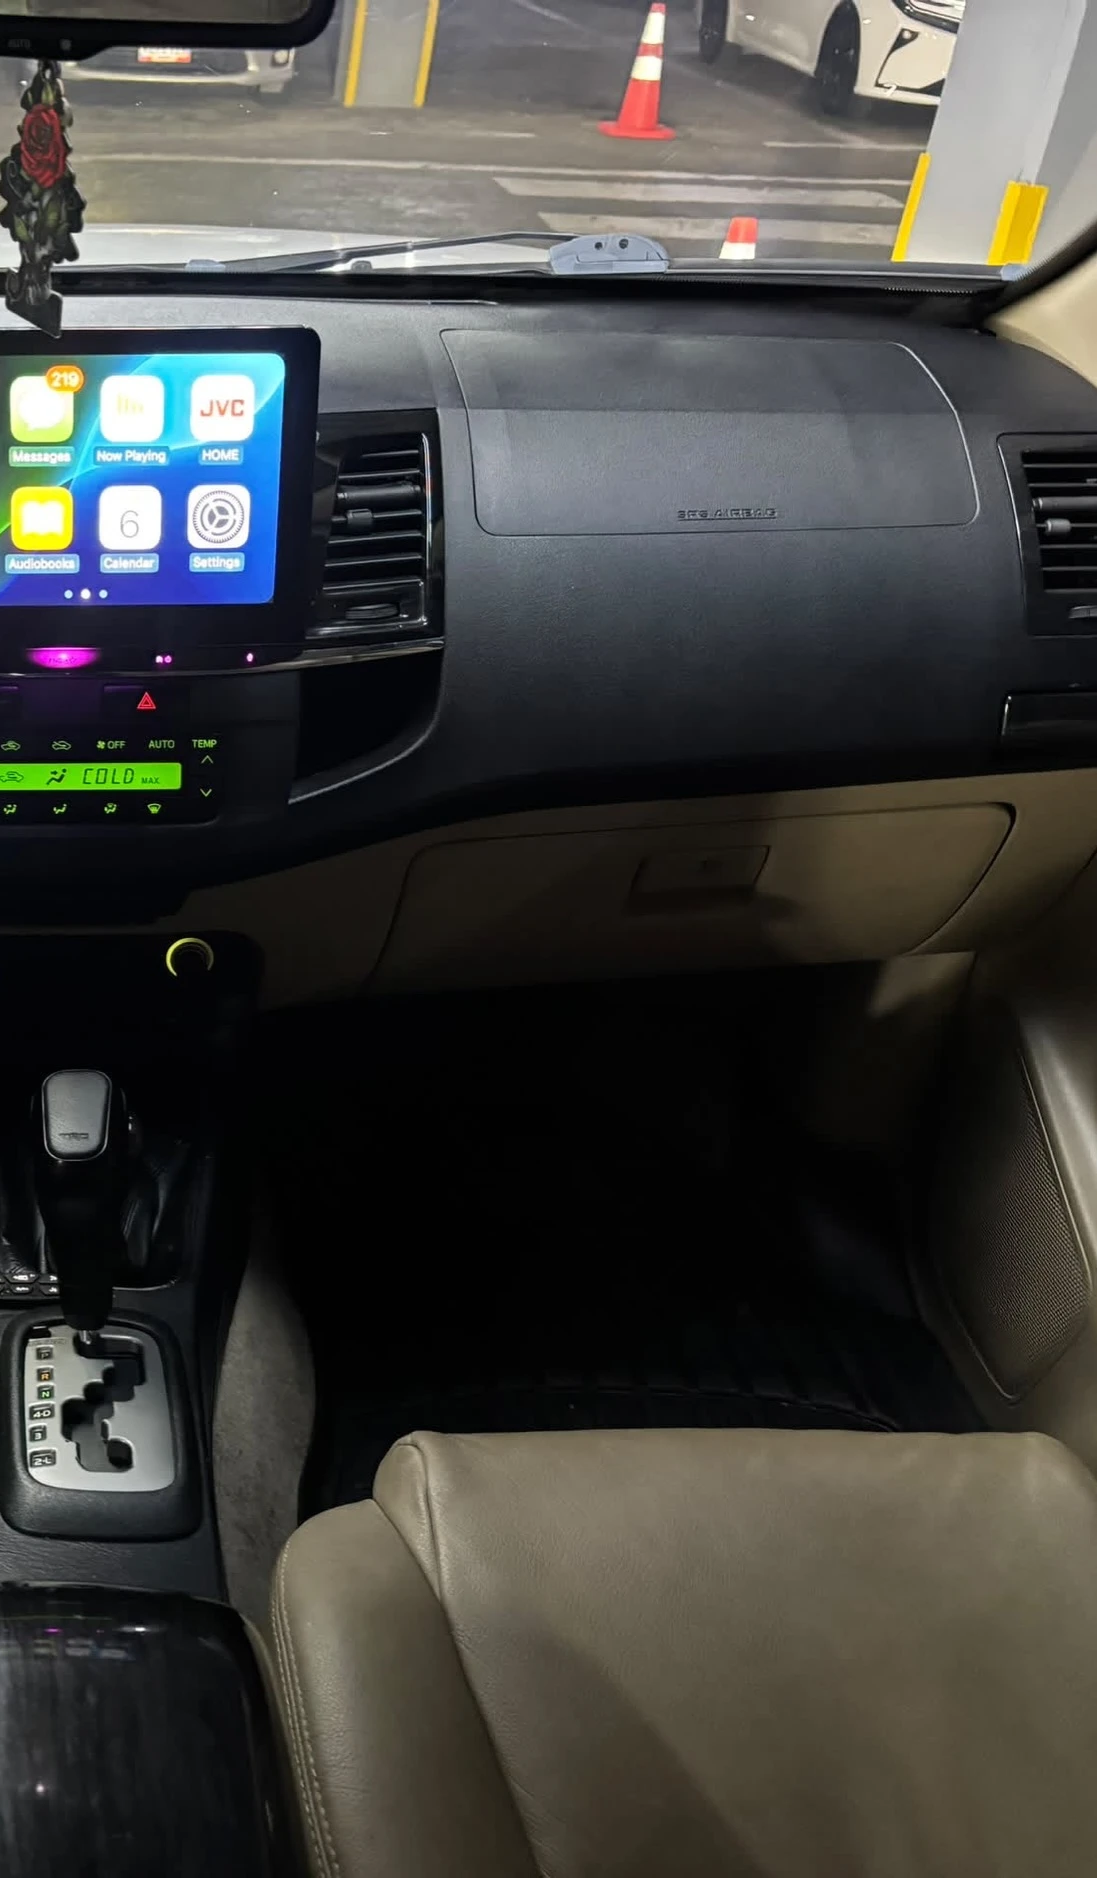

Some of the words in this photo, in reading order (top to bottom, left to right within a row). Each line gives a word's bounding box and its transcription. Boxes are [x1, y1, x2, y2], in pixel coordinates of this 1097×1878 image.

[51, 372, 79, 388] 219
[200, 399, 245, 417] JVC
[12, 450, 71, 463] Messages
[96, 450, 121, 462] Now
[125, 449, 166, 464] Playing
[202, 449, 239, 461] HOME
[119, 510, 140, 538] 6
[8, 558, 75, 570] Audiobooks
[103, 557, 155, 570] Calendar
[193, 556, 240, 571] Settings
[107, 740, 126, 750] OFF
[148, 739, 175, 749] AUTO
[192, 739, 217, 748] TEMP
[82, 768, 135, 785] COLD
[41, 1390, 50, 1398] N
